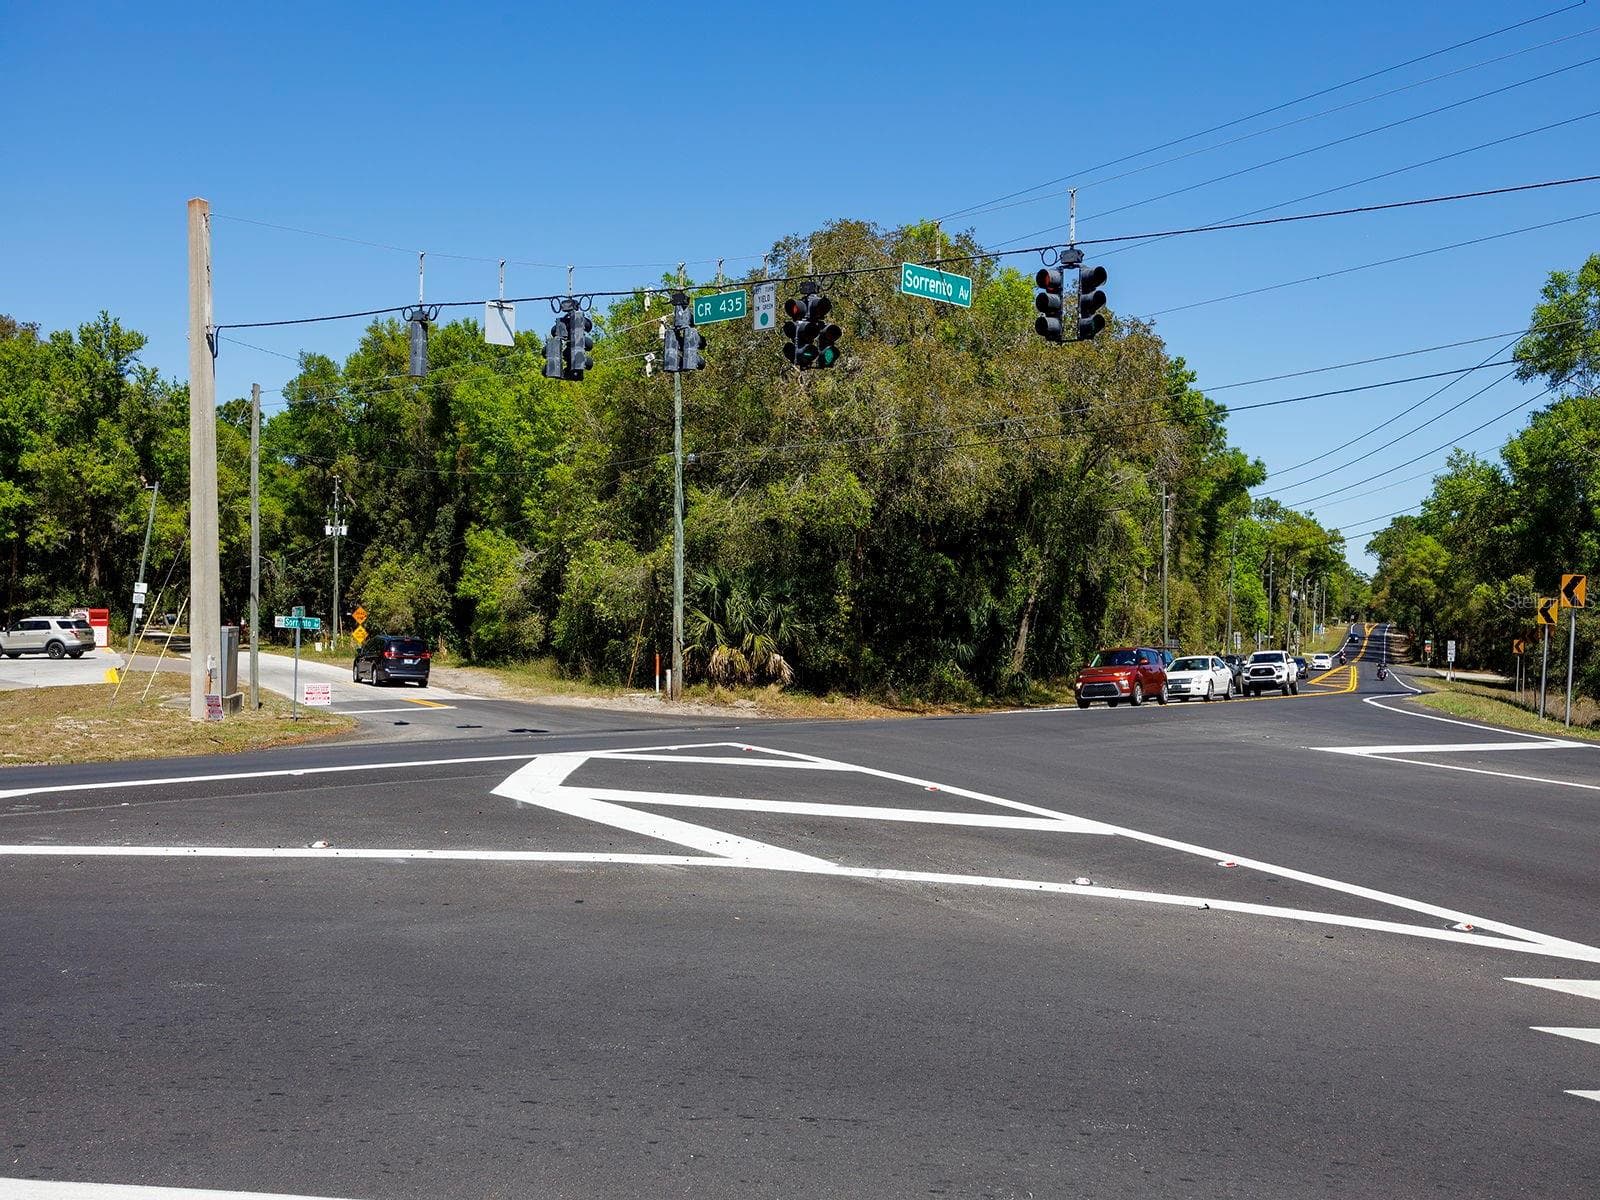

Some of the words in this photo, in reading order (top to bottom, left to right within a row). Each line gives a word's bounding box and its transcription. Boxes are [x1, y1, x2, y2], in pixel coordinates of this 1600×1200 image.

[905, 270, 953, 297] Sorrento
[958, 285, 969, 301] Av
[697, 302, 712, 317] CR
[719, 297, 742, 313] 435
[285, 618, 312, 628] Sorrnto
